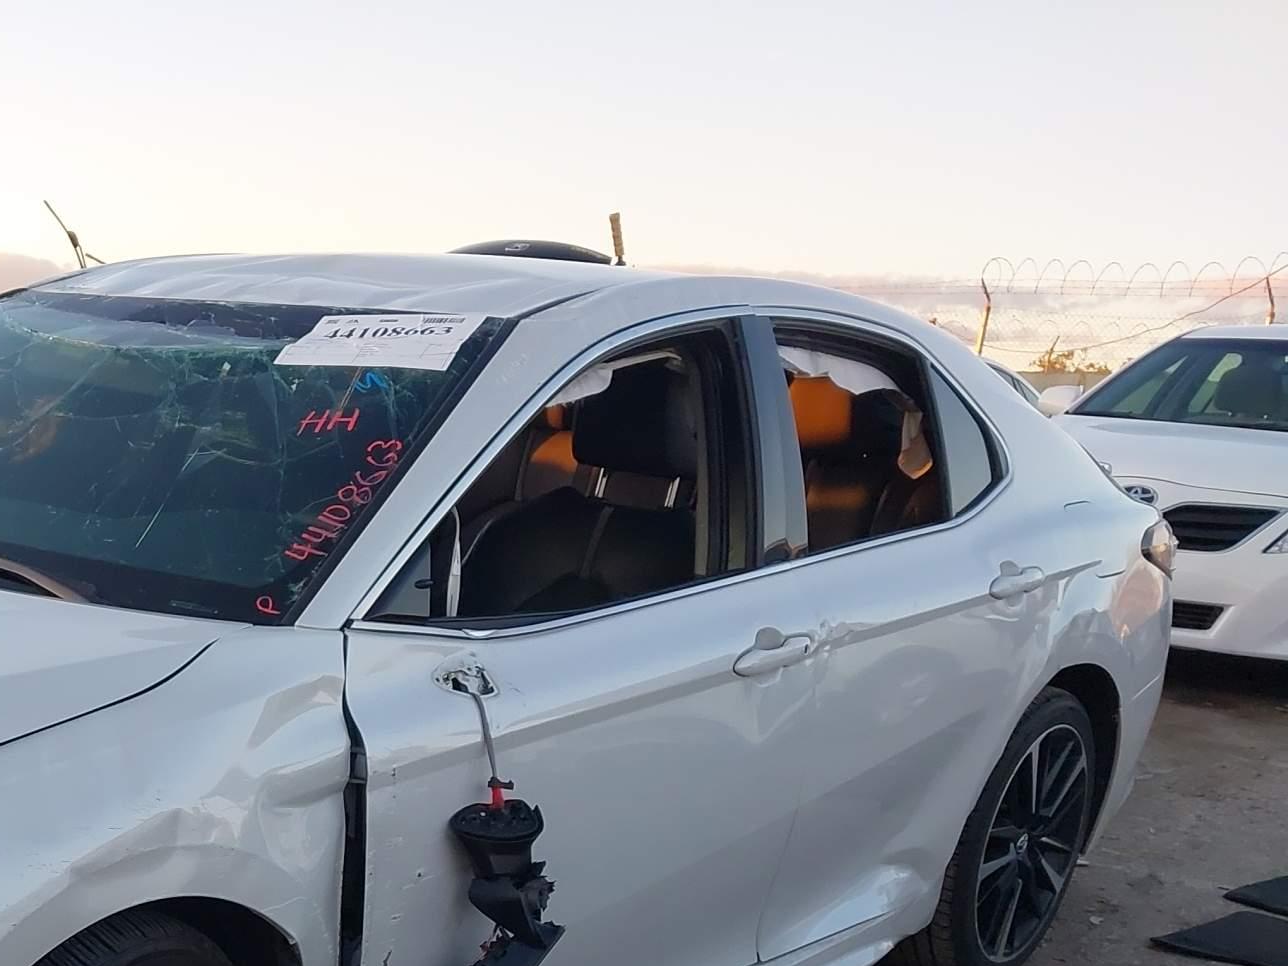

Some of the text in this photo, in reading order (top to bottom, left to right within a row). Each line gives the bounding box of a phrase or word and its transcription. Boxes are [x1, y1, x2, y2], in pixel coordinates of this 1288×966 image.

[324, 325, 454, 339] 44108663
[297, 408, 360, 436] HH
[255, 595, 281, 616] P
